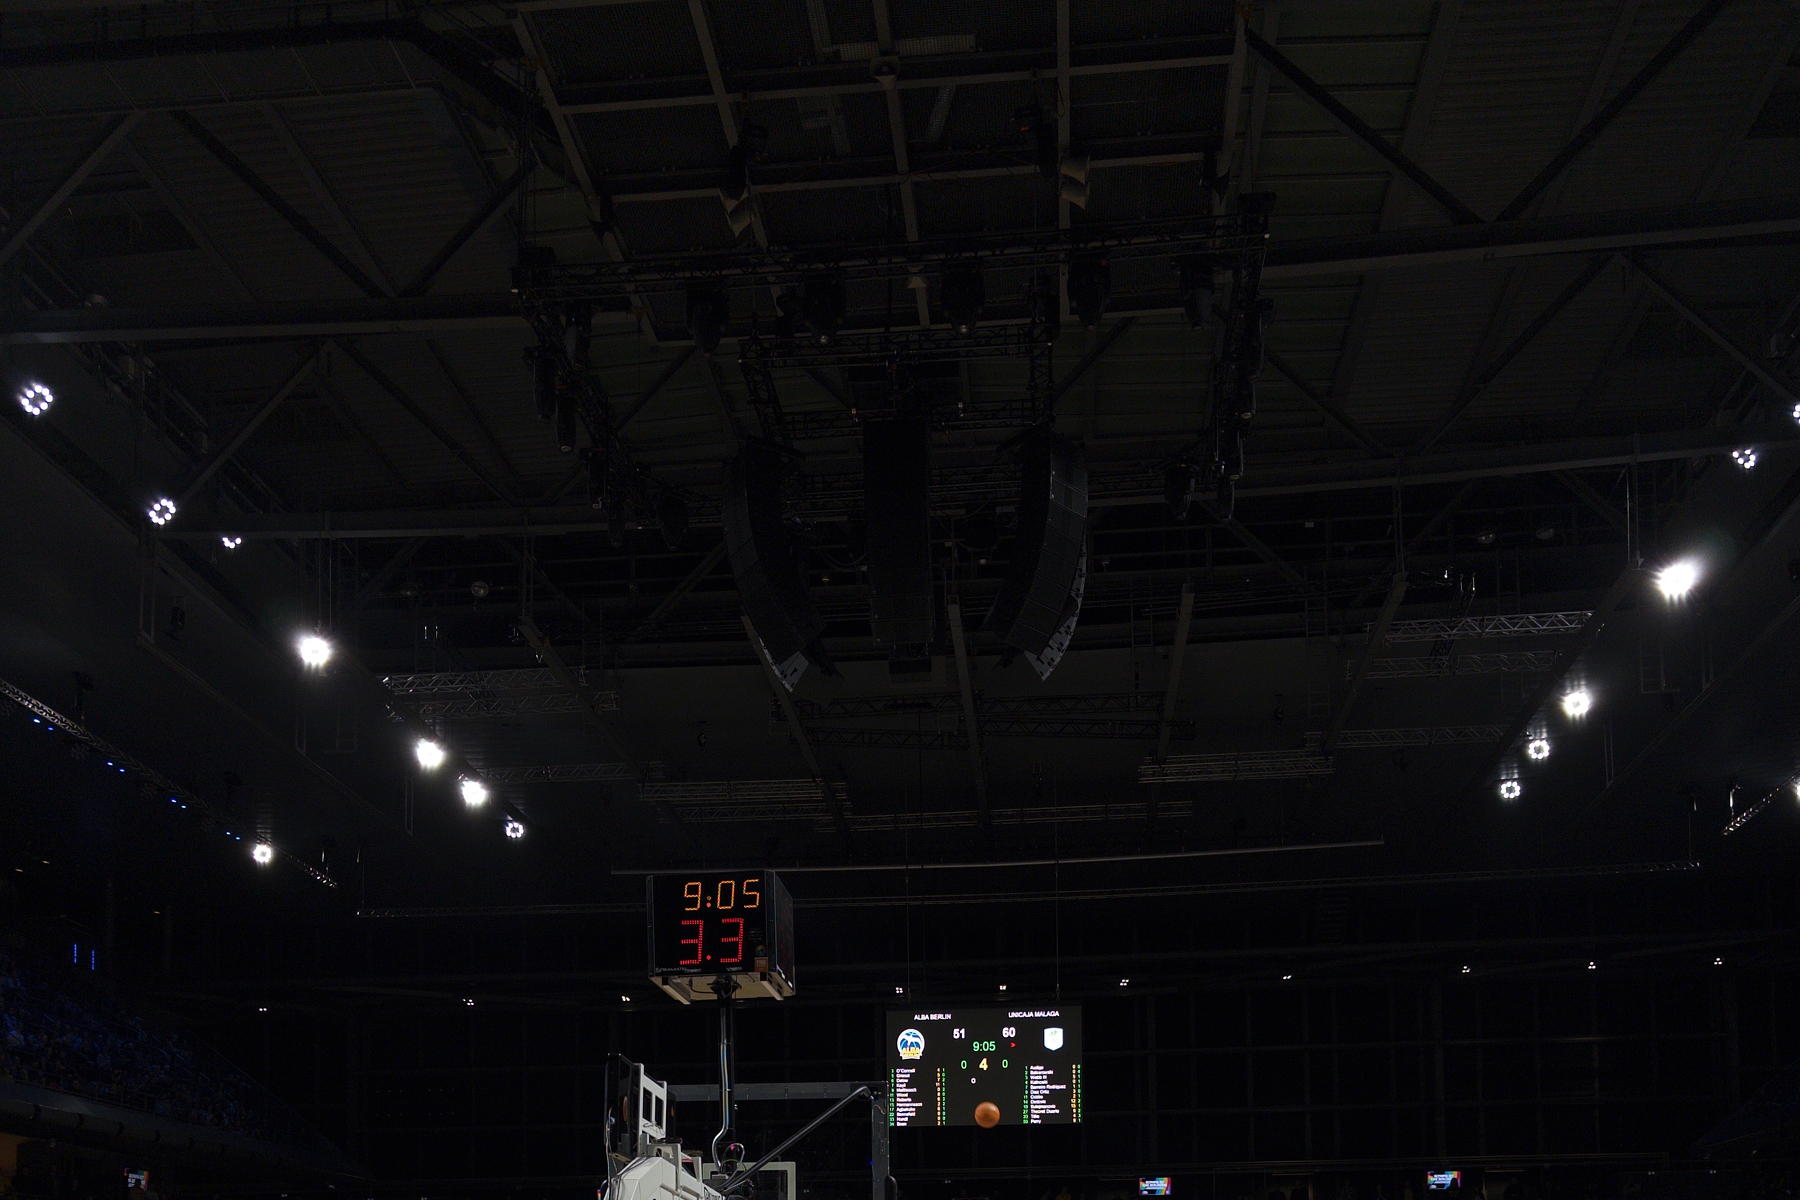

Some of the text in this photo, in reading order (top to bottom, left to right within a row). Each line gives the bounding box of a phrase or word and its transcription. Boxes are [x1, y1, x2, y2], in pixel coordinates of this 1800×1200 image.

[684, 879, 760, 911] 9:05
[680, 918, 744, 965] 3.3
[953, 1028, 966, 1039] 51
[1002, 1027, 1016, 1038] 60
[972, 1041, 996, 1052] 9:05
[979, 1058, 989, 1070] 4
